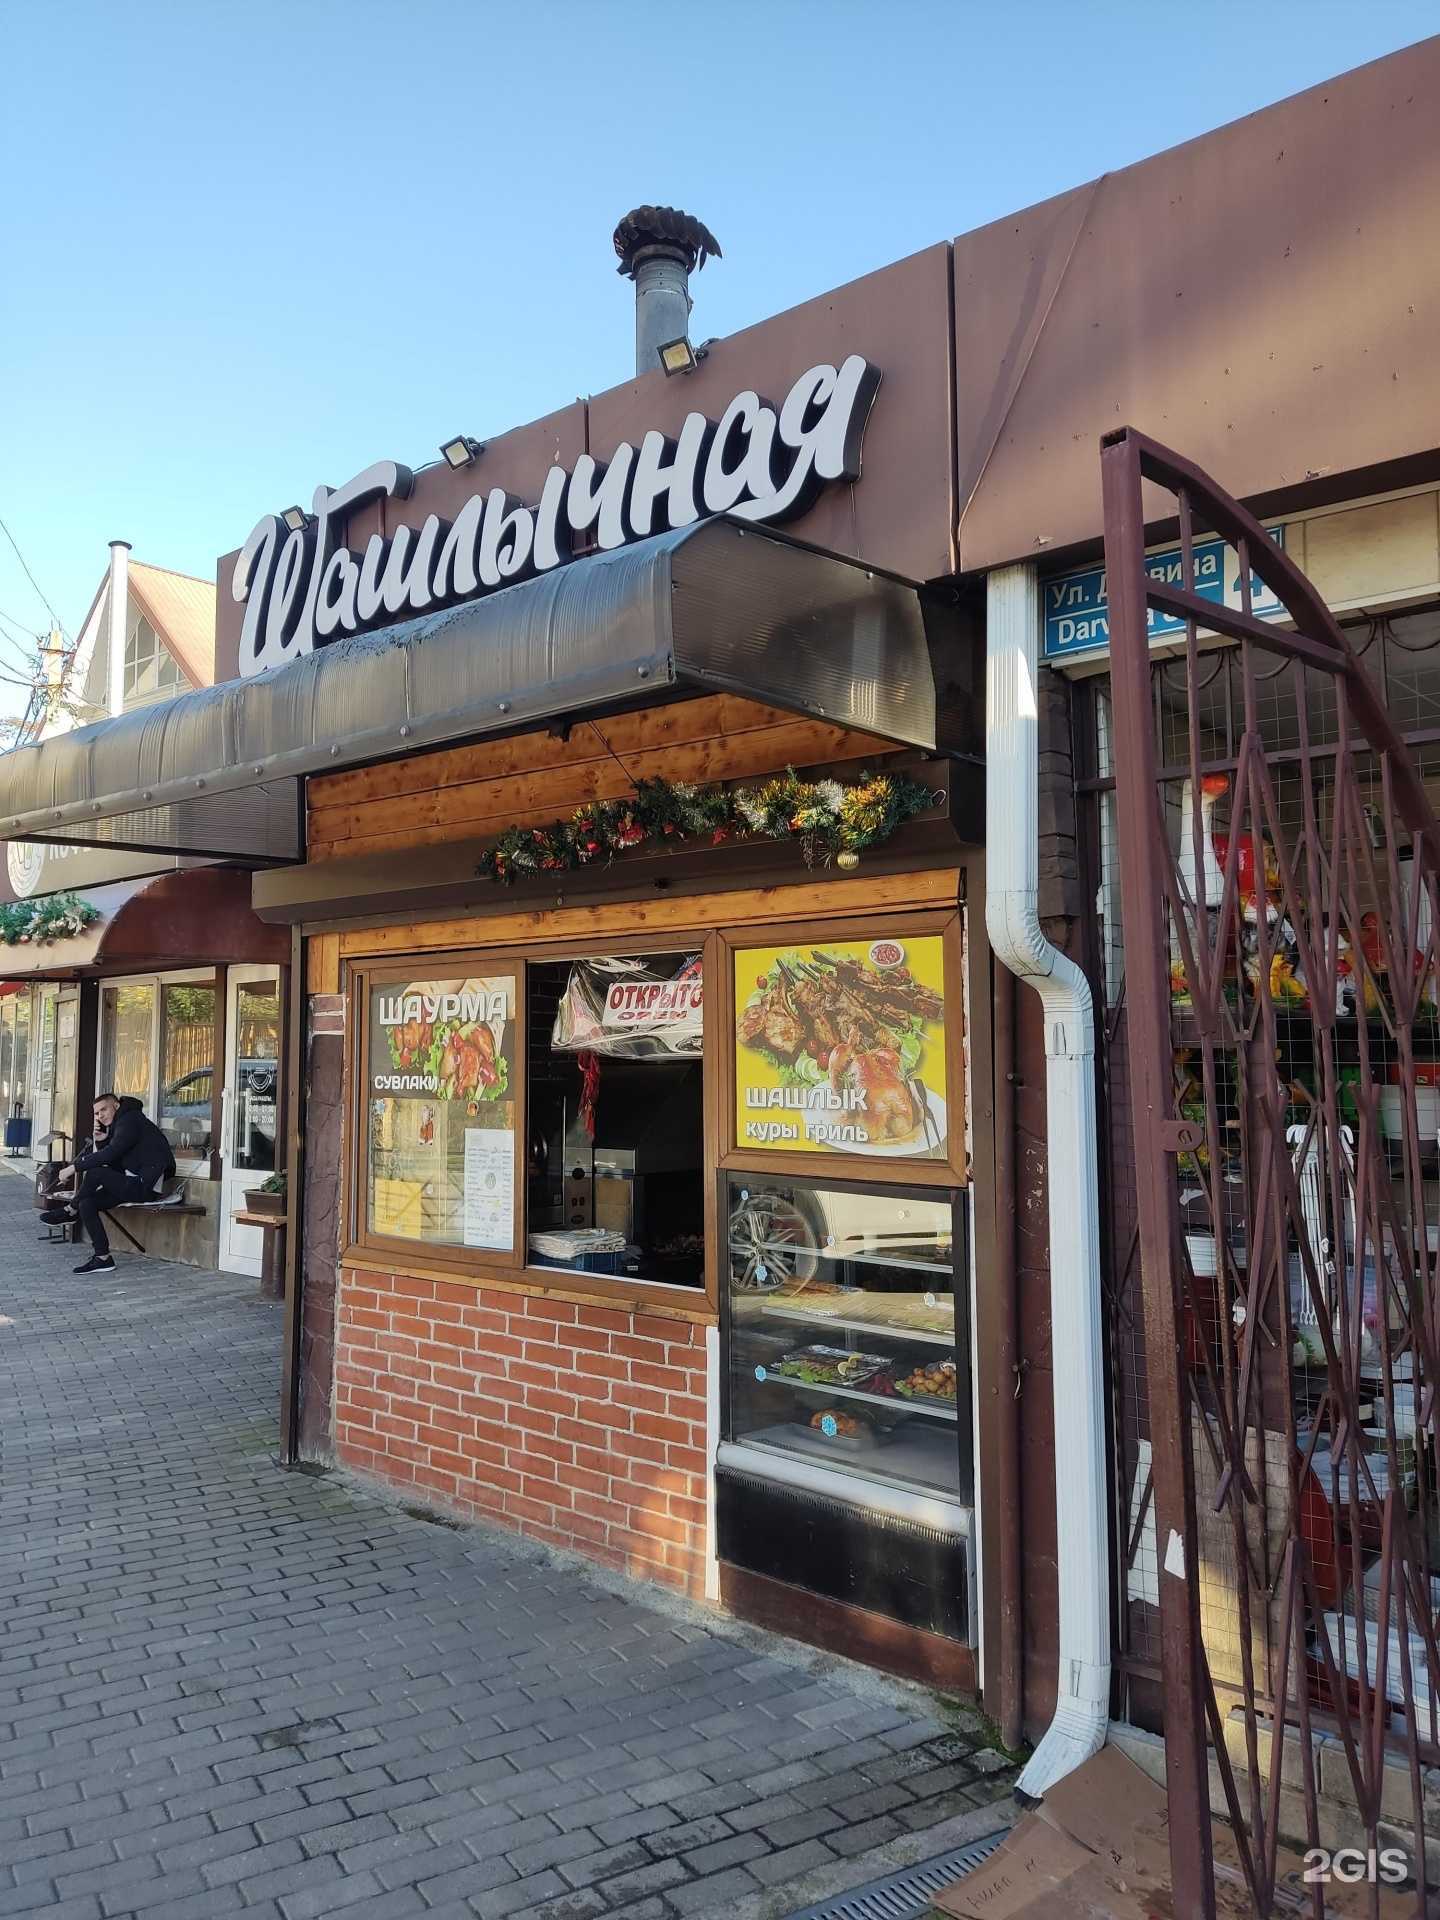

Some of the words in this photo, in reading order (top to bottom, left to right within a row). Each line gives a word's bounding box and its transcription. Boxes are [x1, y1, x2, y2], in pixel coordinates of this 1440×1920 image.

[233, 355, 869, 676] Шашлычная
[379, 991, 507, 1025] ШАУРМА
[374, 1075, 438, 1090] СУВЛАКИ
[745, 1087, 868, 1111] ШАШЛЫК
[745, 1121, 798, 1142] куры
[804, 1123, 869, 1144] гриль
